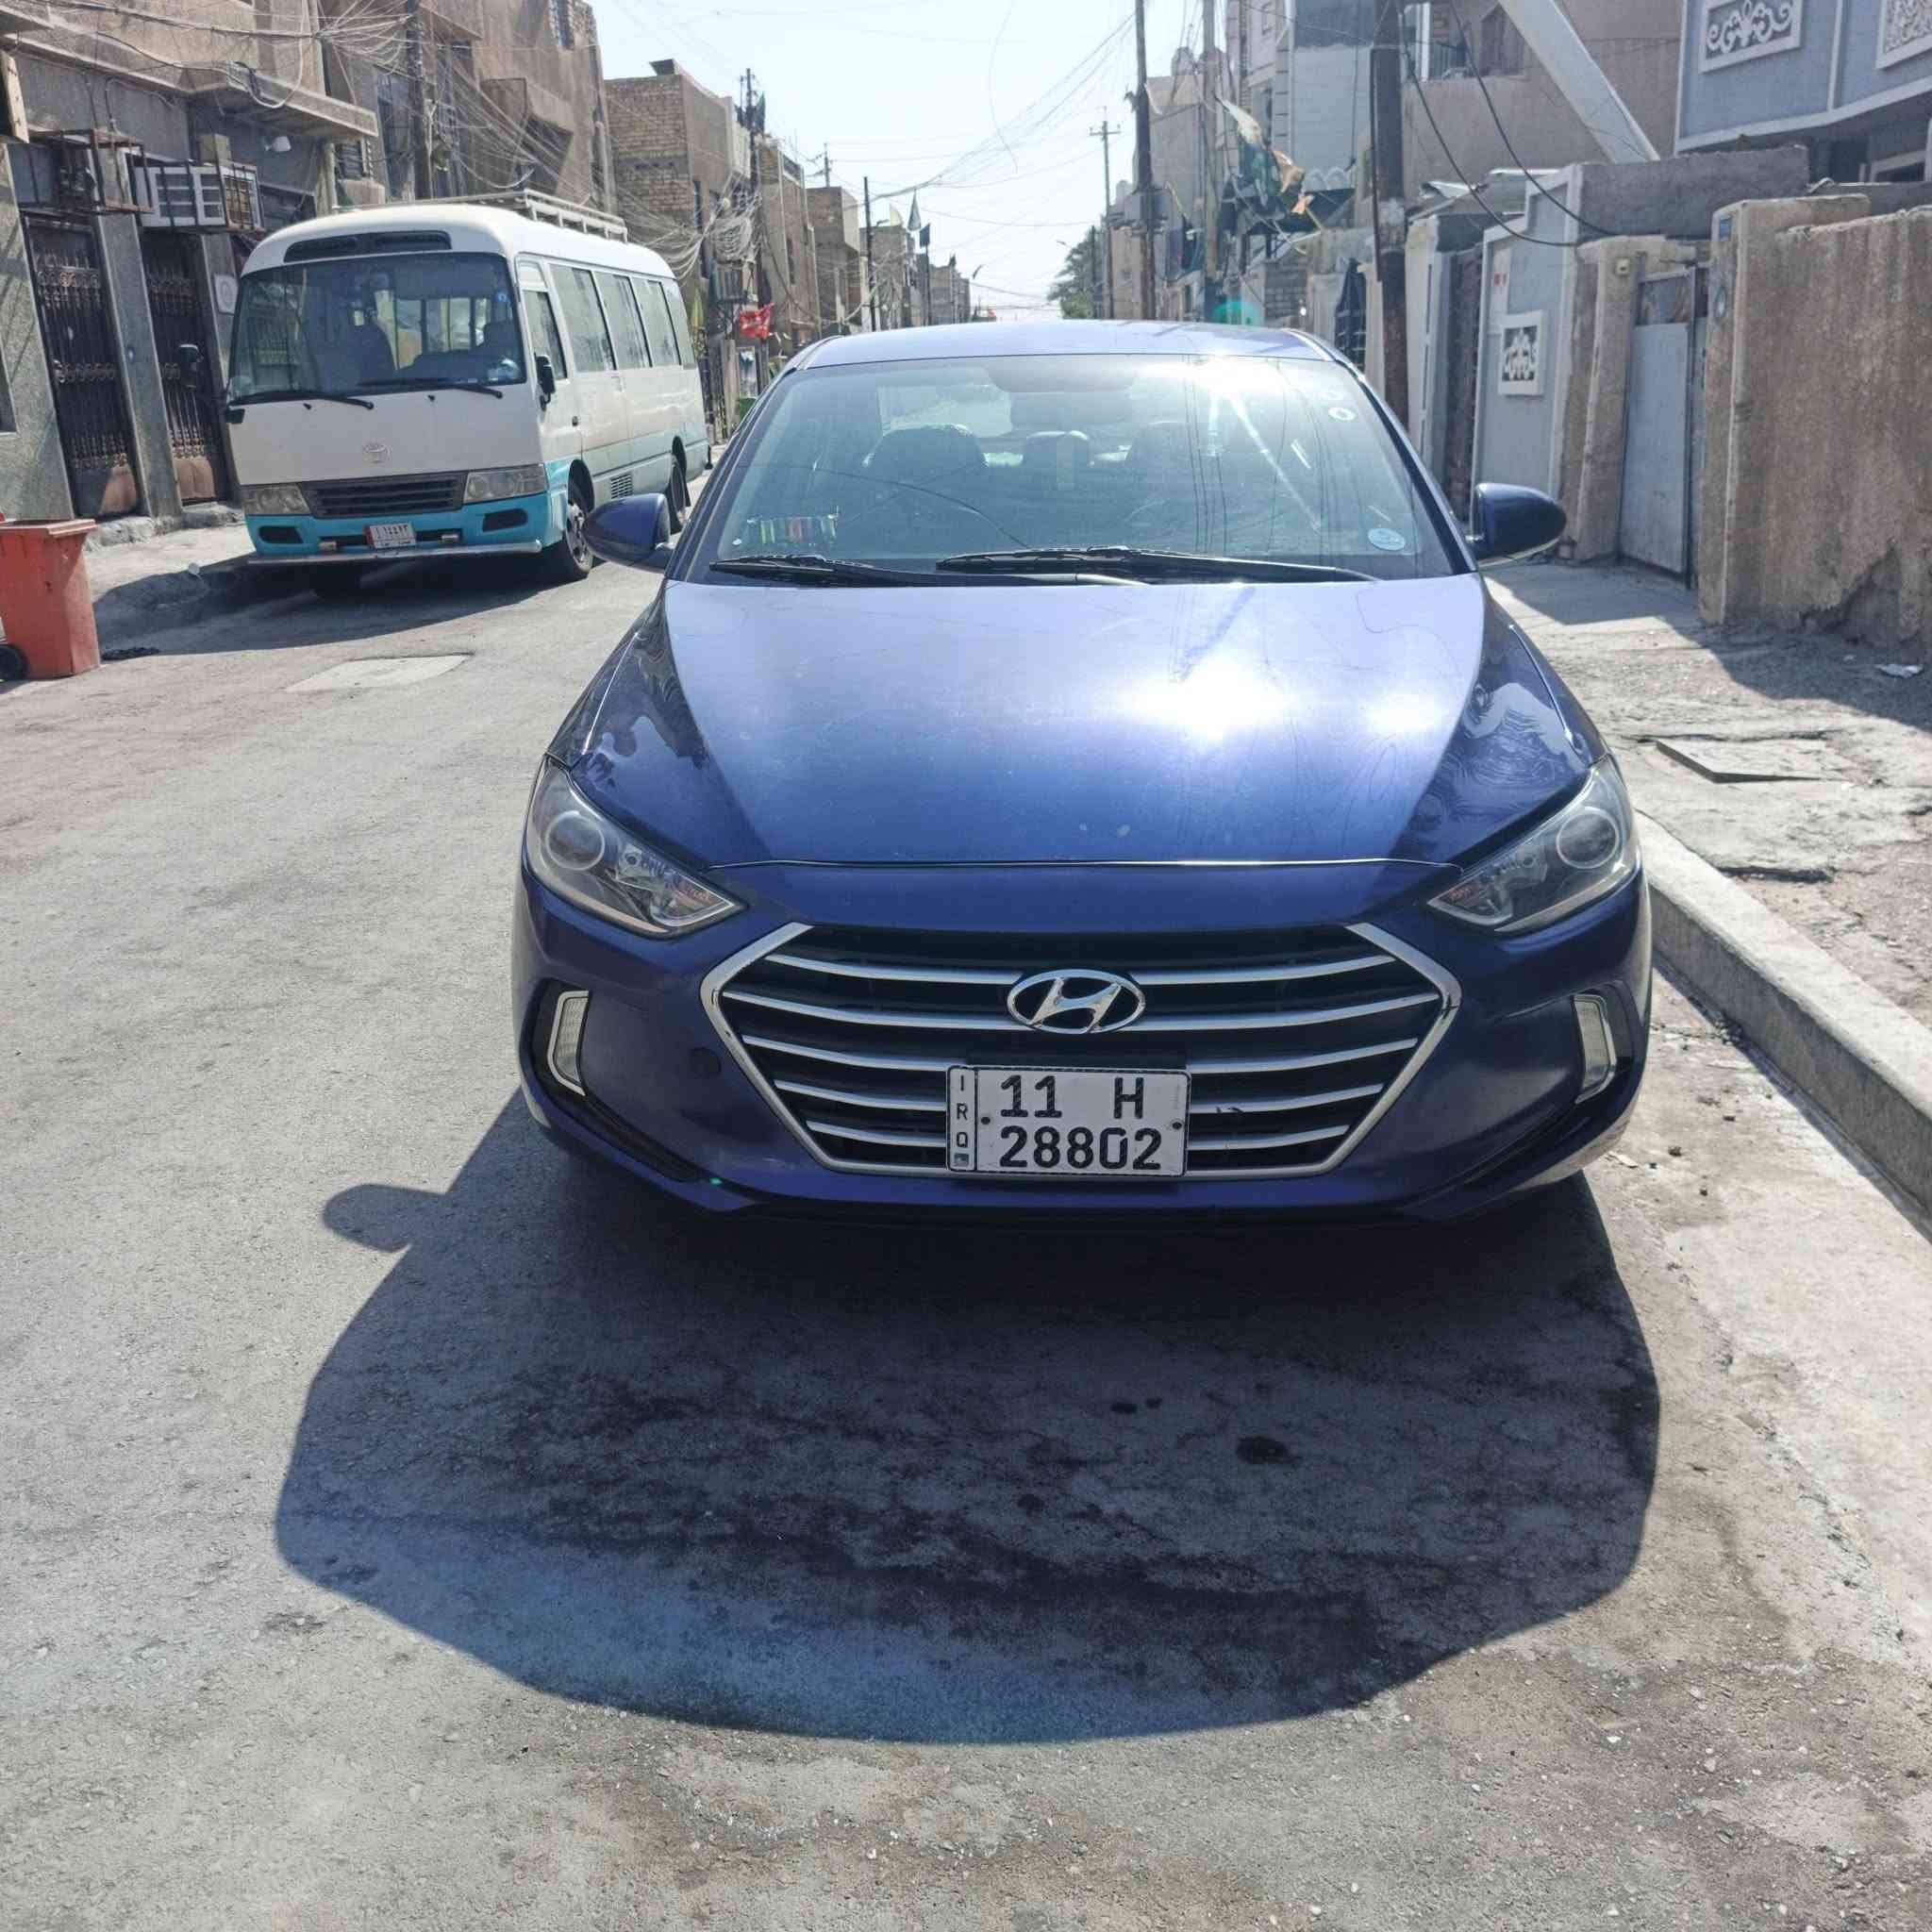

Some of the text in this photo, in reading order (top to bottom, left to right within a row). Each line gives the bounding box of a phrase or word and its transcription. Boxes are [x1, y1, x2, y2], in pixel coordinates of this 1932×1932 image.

[1000, 1074, 1144, 1120] 11 H
[999, 1124, 1162, 1171] 28802
